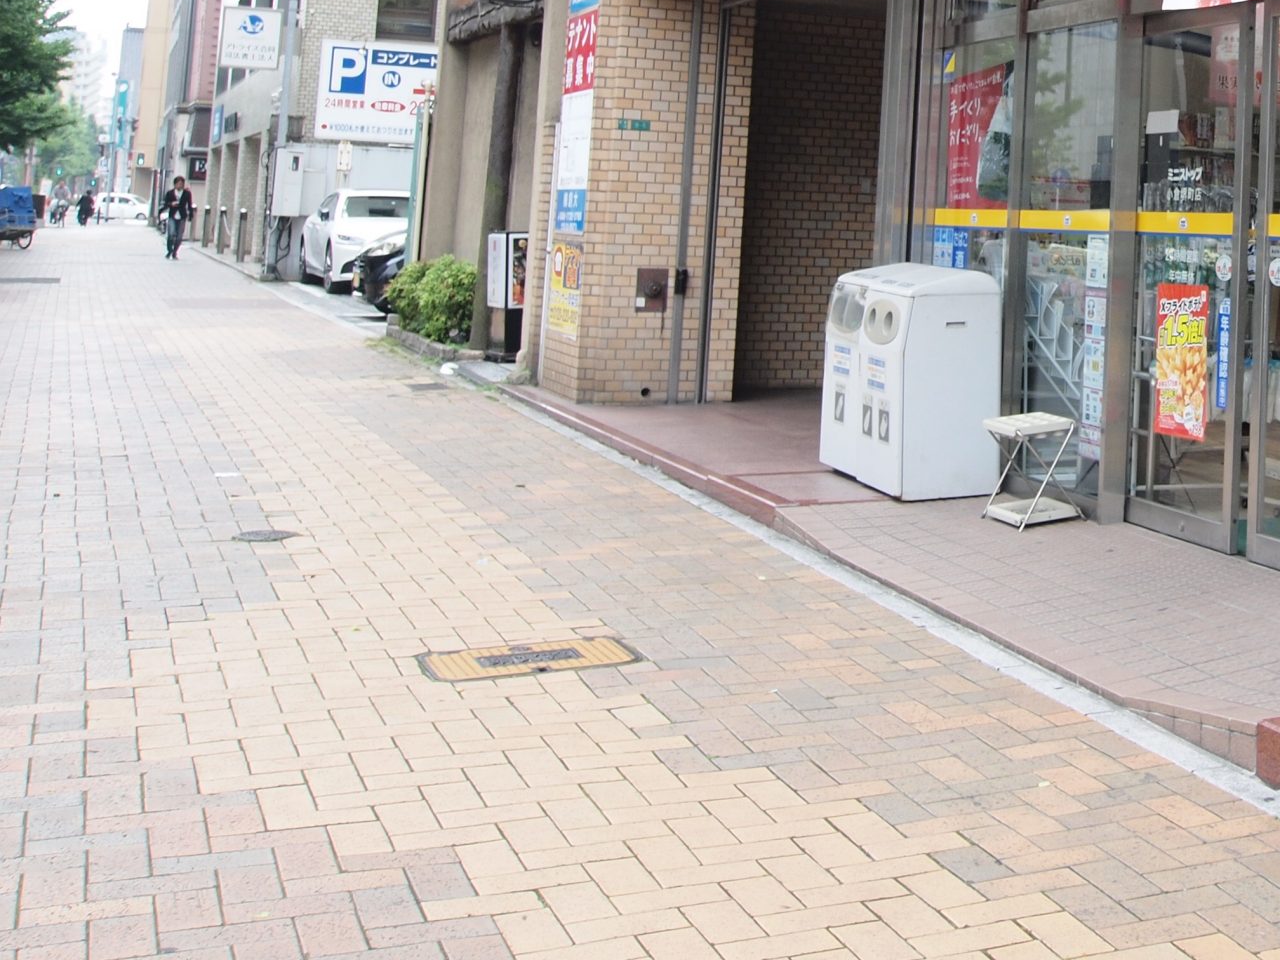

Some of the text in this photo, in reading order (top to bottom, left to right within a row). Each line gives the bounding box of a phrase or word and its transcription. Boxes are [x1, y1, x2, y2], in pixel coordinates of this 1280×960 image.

[568, 13, 597, 52] テナント
[330, 47, 366, 92] P
[384, 73, 400, 86] IN
[565, 51, 595, 89] 募集中
[324, 97, 365, 109] 24時間営業
[1167, 167, 1203, 181] ミニストップ
